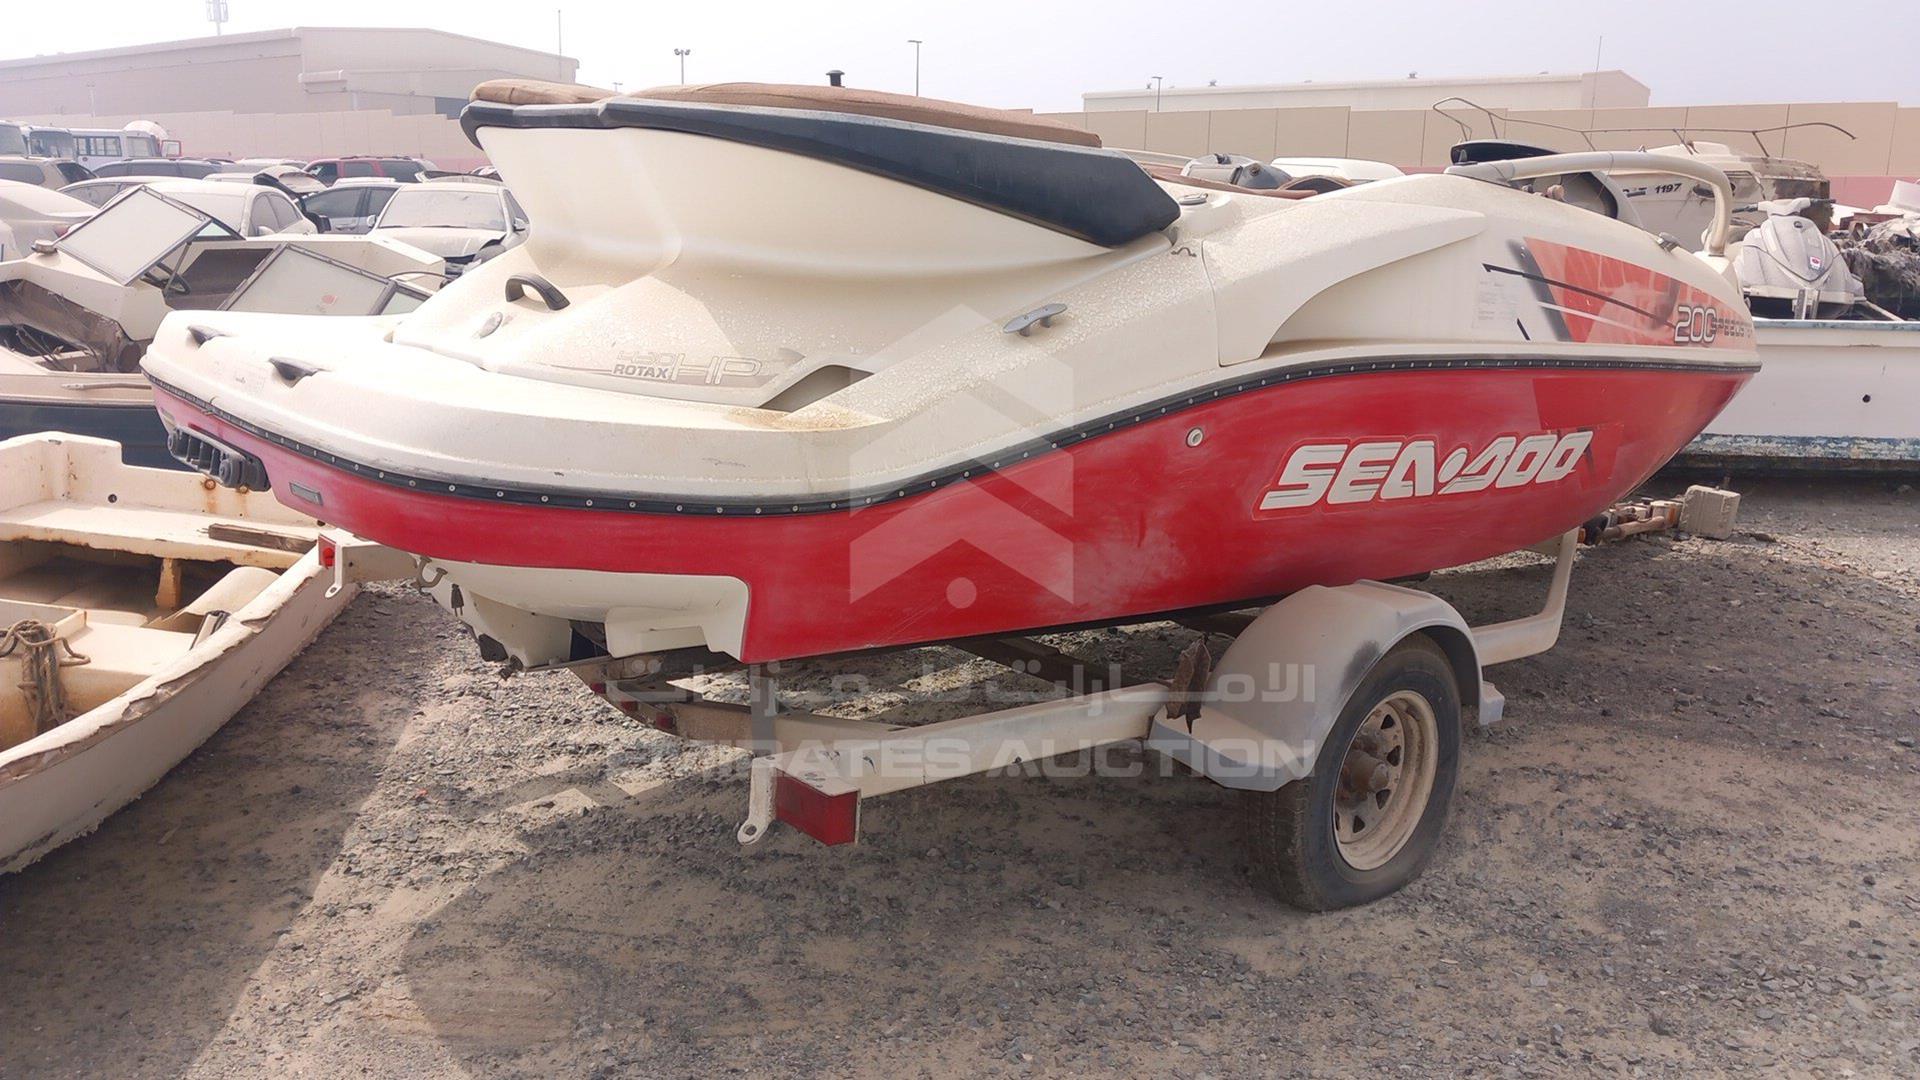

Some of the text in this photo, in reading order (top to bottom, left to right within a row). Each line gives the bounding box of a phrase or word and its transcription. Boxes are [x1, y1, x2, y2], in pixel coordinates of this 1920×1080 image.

[1654, 183, 1682, 194] 1197
[1674, 305, 1717, 343] 200
[612, 363, 669, 380] ROTAX
